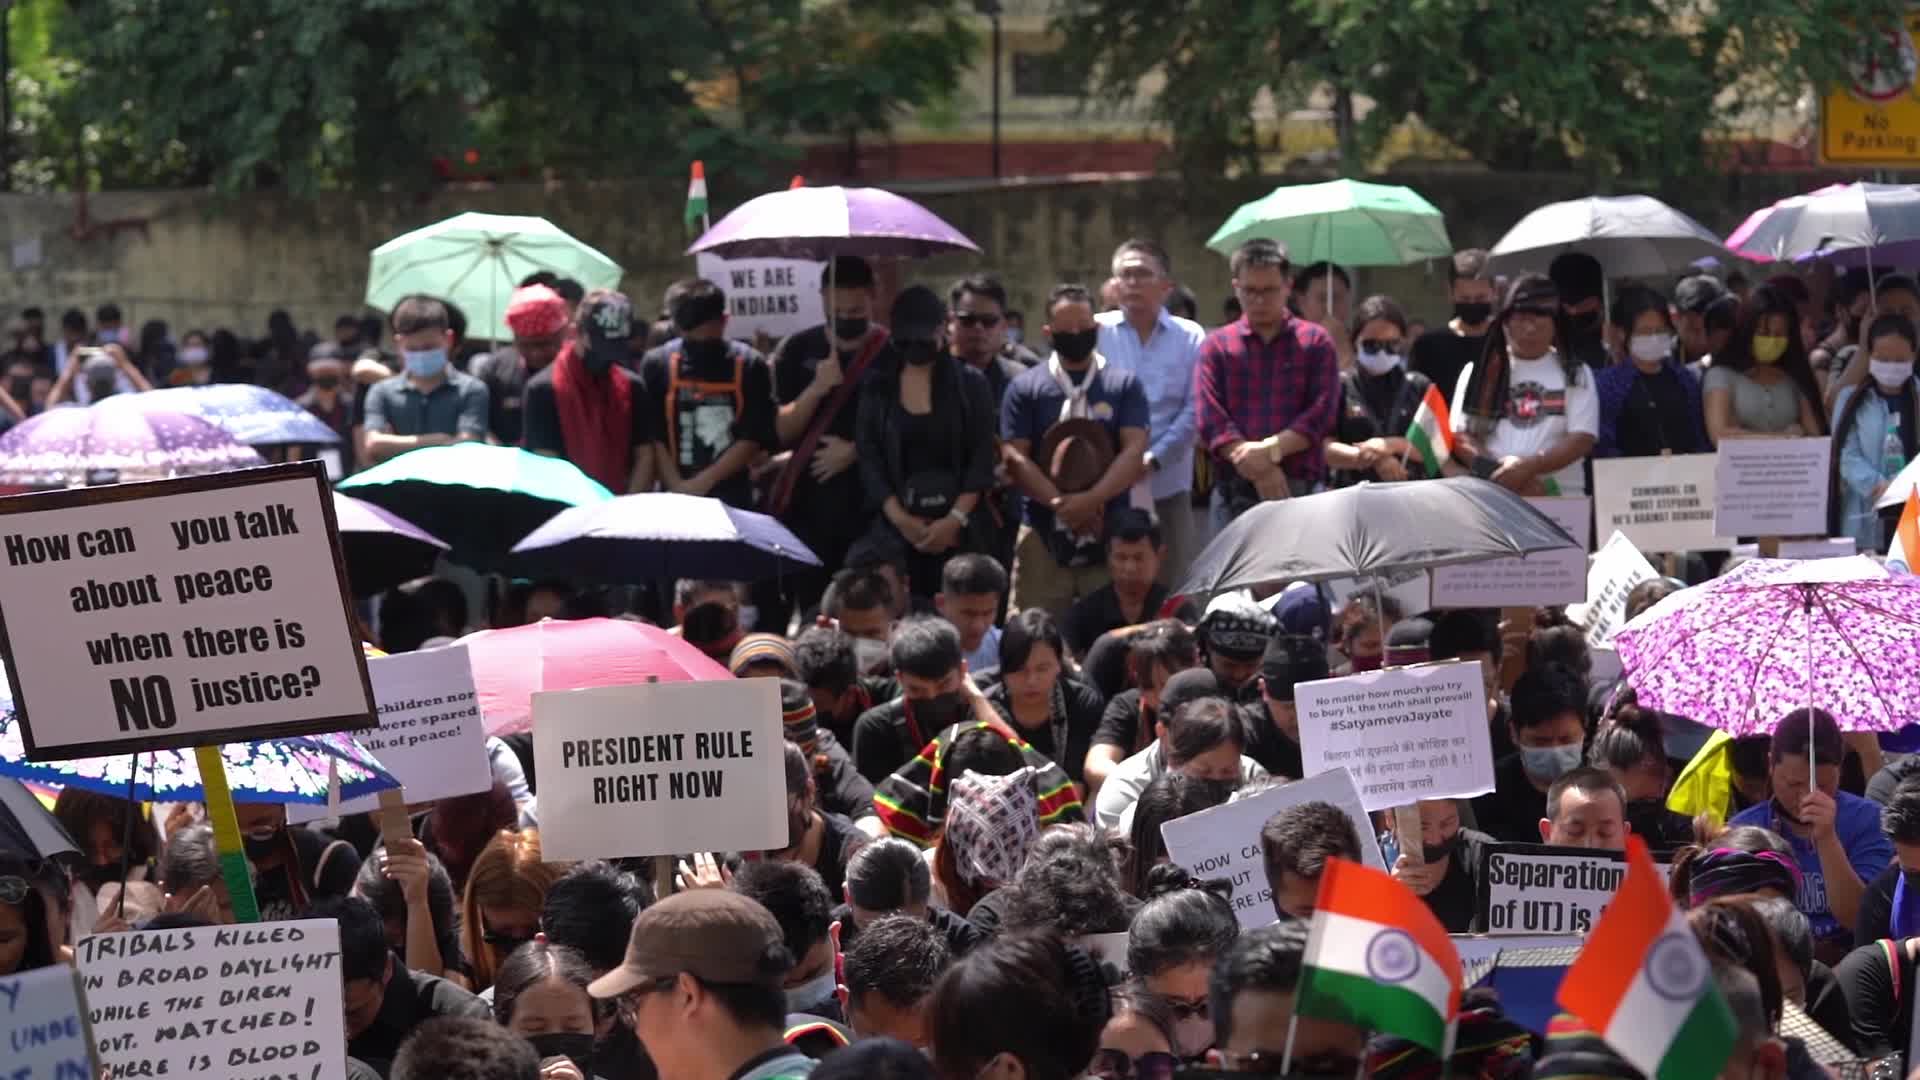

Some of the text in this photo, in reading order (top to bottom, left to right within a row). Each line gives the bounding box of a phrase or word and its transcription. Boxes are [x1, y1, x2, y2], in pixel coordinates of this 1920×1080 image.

[1863, 114, 1889, 130] No
[1842, 129, 1918, 153] Parking
[730, 266, 796, 289] WE ARE
[730, 294, 799, 316] INDIANS
[4, 503, 300, 567] How can you talk
[70, 564, 274, 613] about peace
[86, 619, 306, 666] when there is
[110, 665, 321, 732] NO justice?
[375, 691, 476, 715] children nor
[1309, 711, 1321, 720] to
[1322, 707, 1345, 720] bury
[1358, 702, 1376, 713] the
[1378, 698, 1406, 710] truth
[1407, 695, 1432, 707] shall
[1316, 681, 1462, 707] No matter how much you try
[379, 718, 417, 733] were
[421, 706, 478, 724] spared
[1329, 708, 1454, 731] #SatyamevaJayate
[389, 735, 406, 748] of
[408, 727, 462, 747] peace!
[562, 730, 754, 768] PRESIDENT RULE
[593, 770, 723, 804] RIGHT NOW
[1193, 845, 1262, 875] HOW CA
[1490, 854, 1625, 892] Separation
[1491, 900, 1517, 929] of
[1570, 903, 1592, 933] is
[78, 928, 305, 963] TRIBALS KILLED
[118, 966, 208, 988] BROAD
[220, 952, 340, 979] DAYLIGHT
[164, 996, 204, 1013] THE
[219, 985, 292, 1007] BIREN
[100, 1033, 138, 1053] OVT.
[188, 1055, 212, 1071] IS
[228, 1040, 321, 1066] BLOOD
